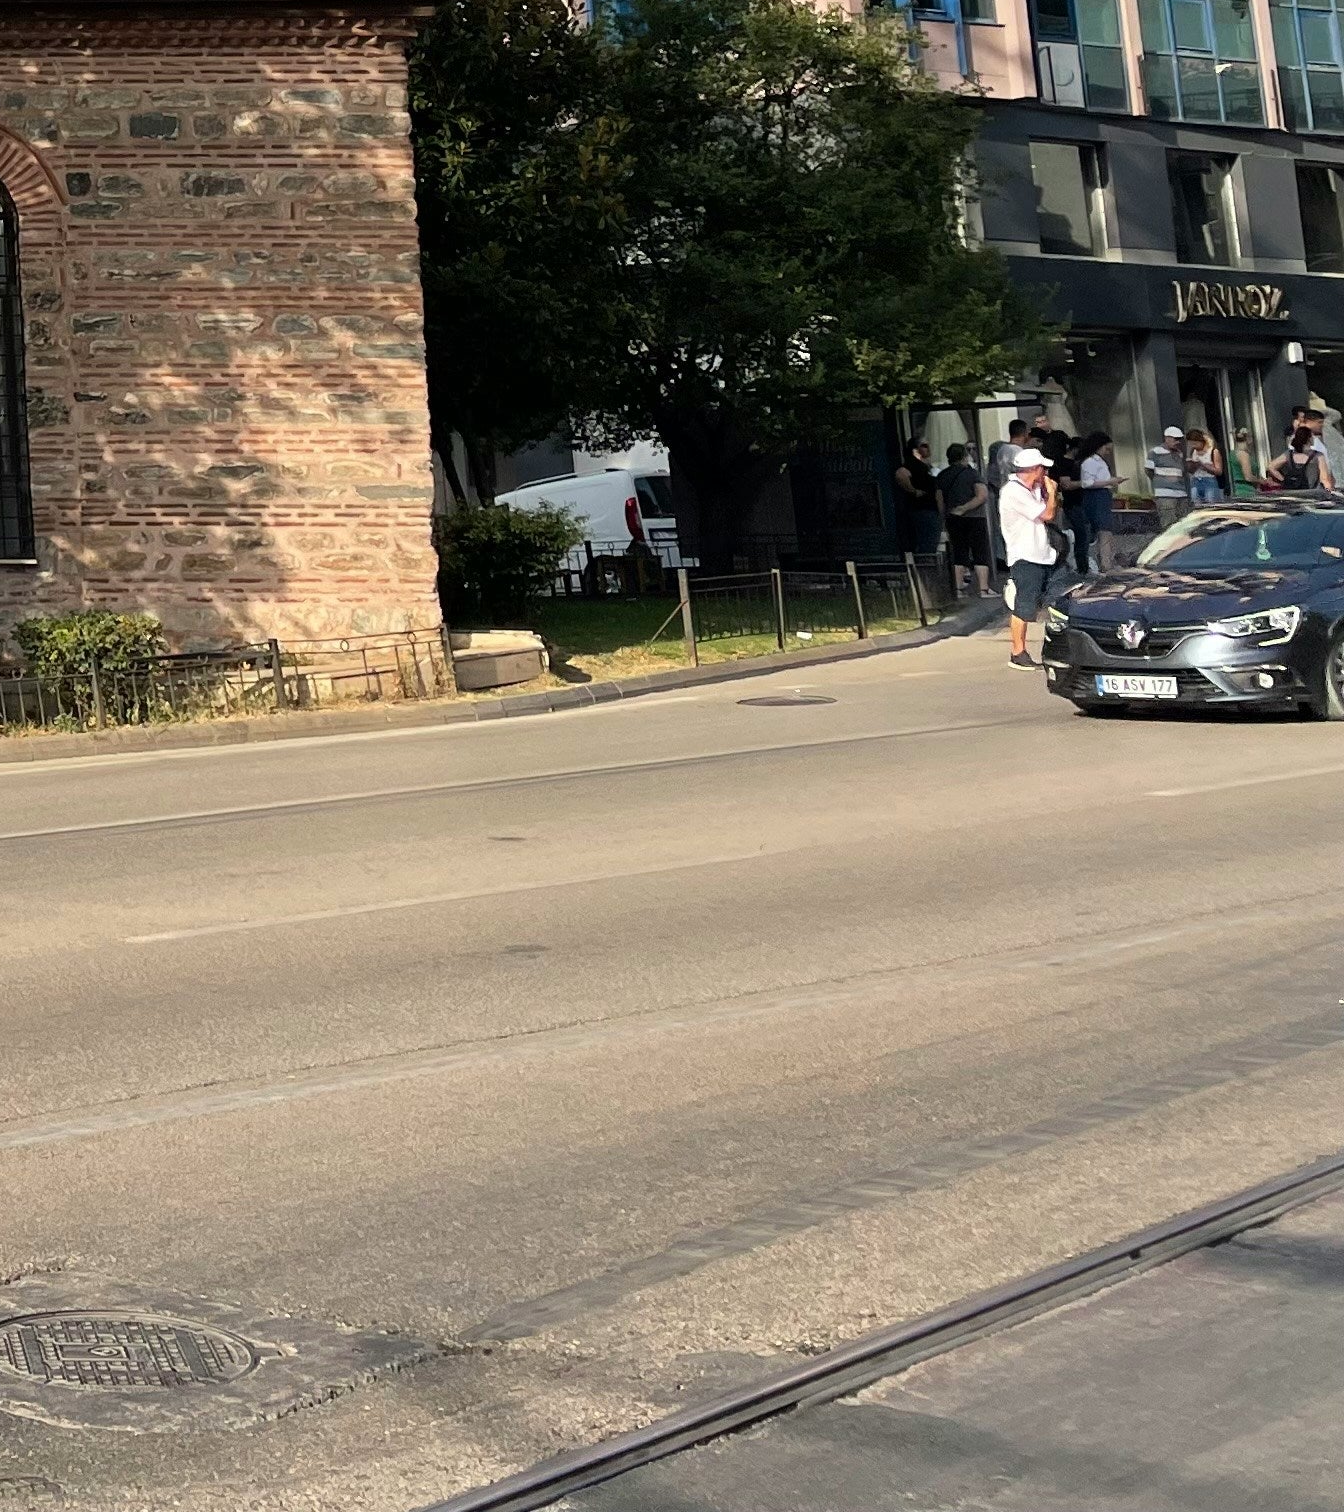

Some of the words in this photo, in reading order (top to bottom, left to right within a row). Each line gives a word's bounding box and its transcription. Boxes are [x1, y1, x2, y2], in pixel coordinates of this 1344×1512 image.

[1105, 678, 1119, 691] 16
[1123, 679, 1146, 692] ASV
[1151, 679, 1172, 693] 177
